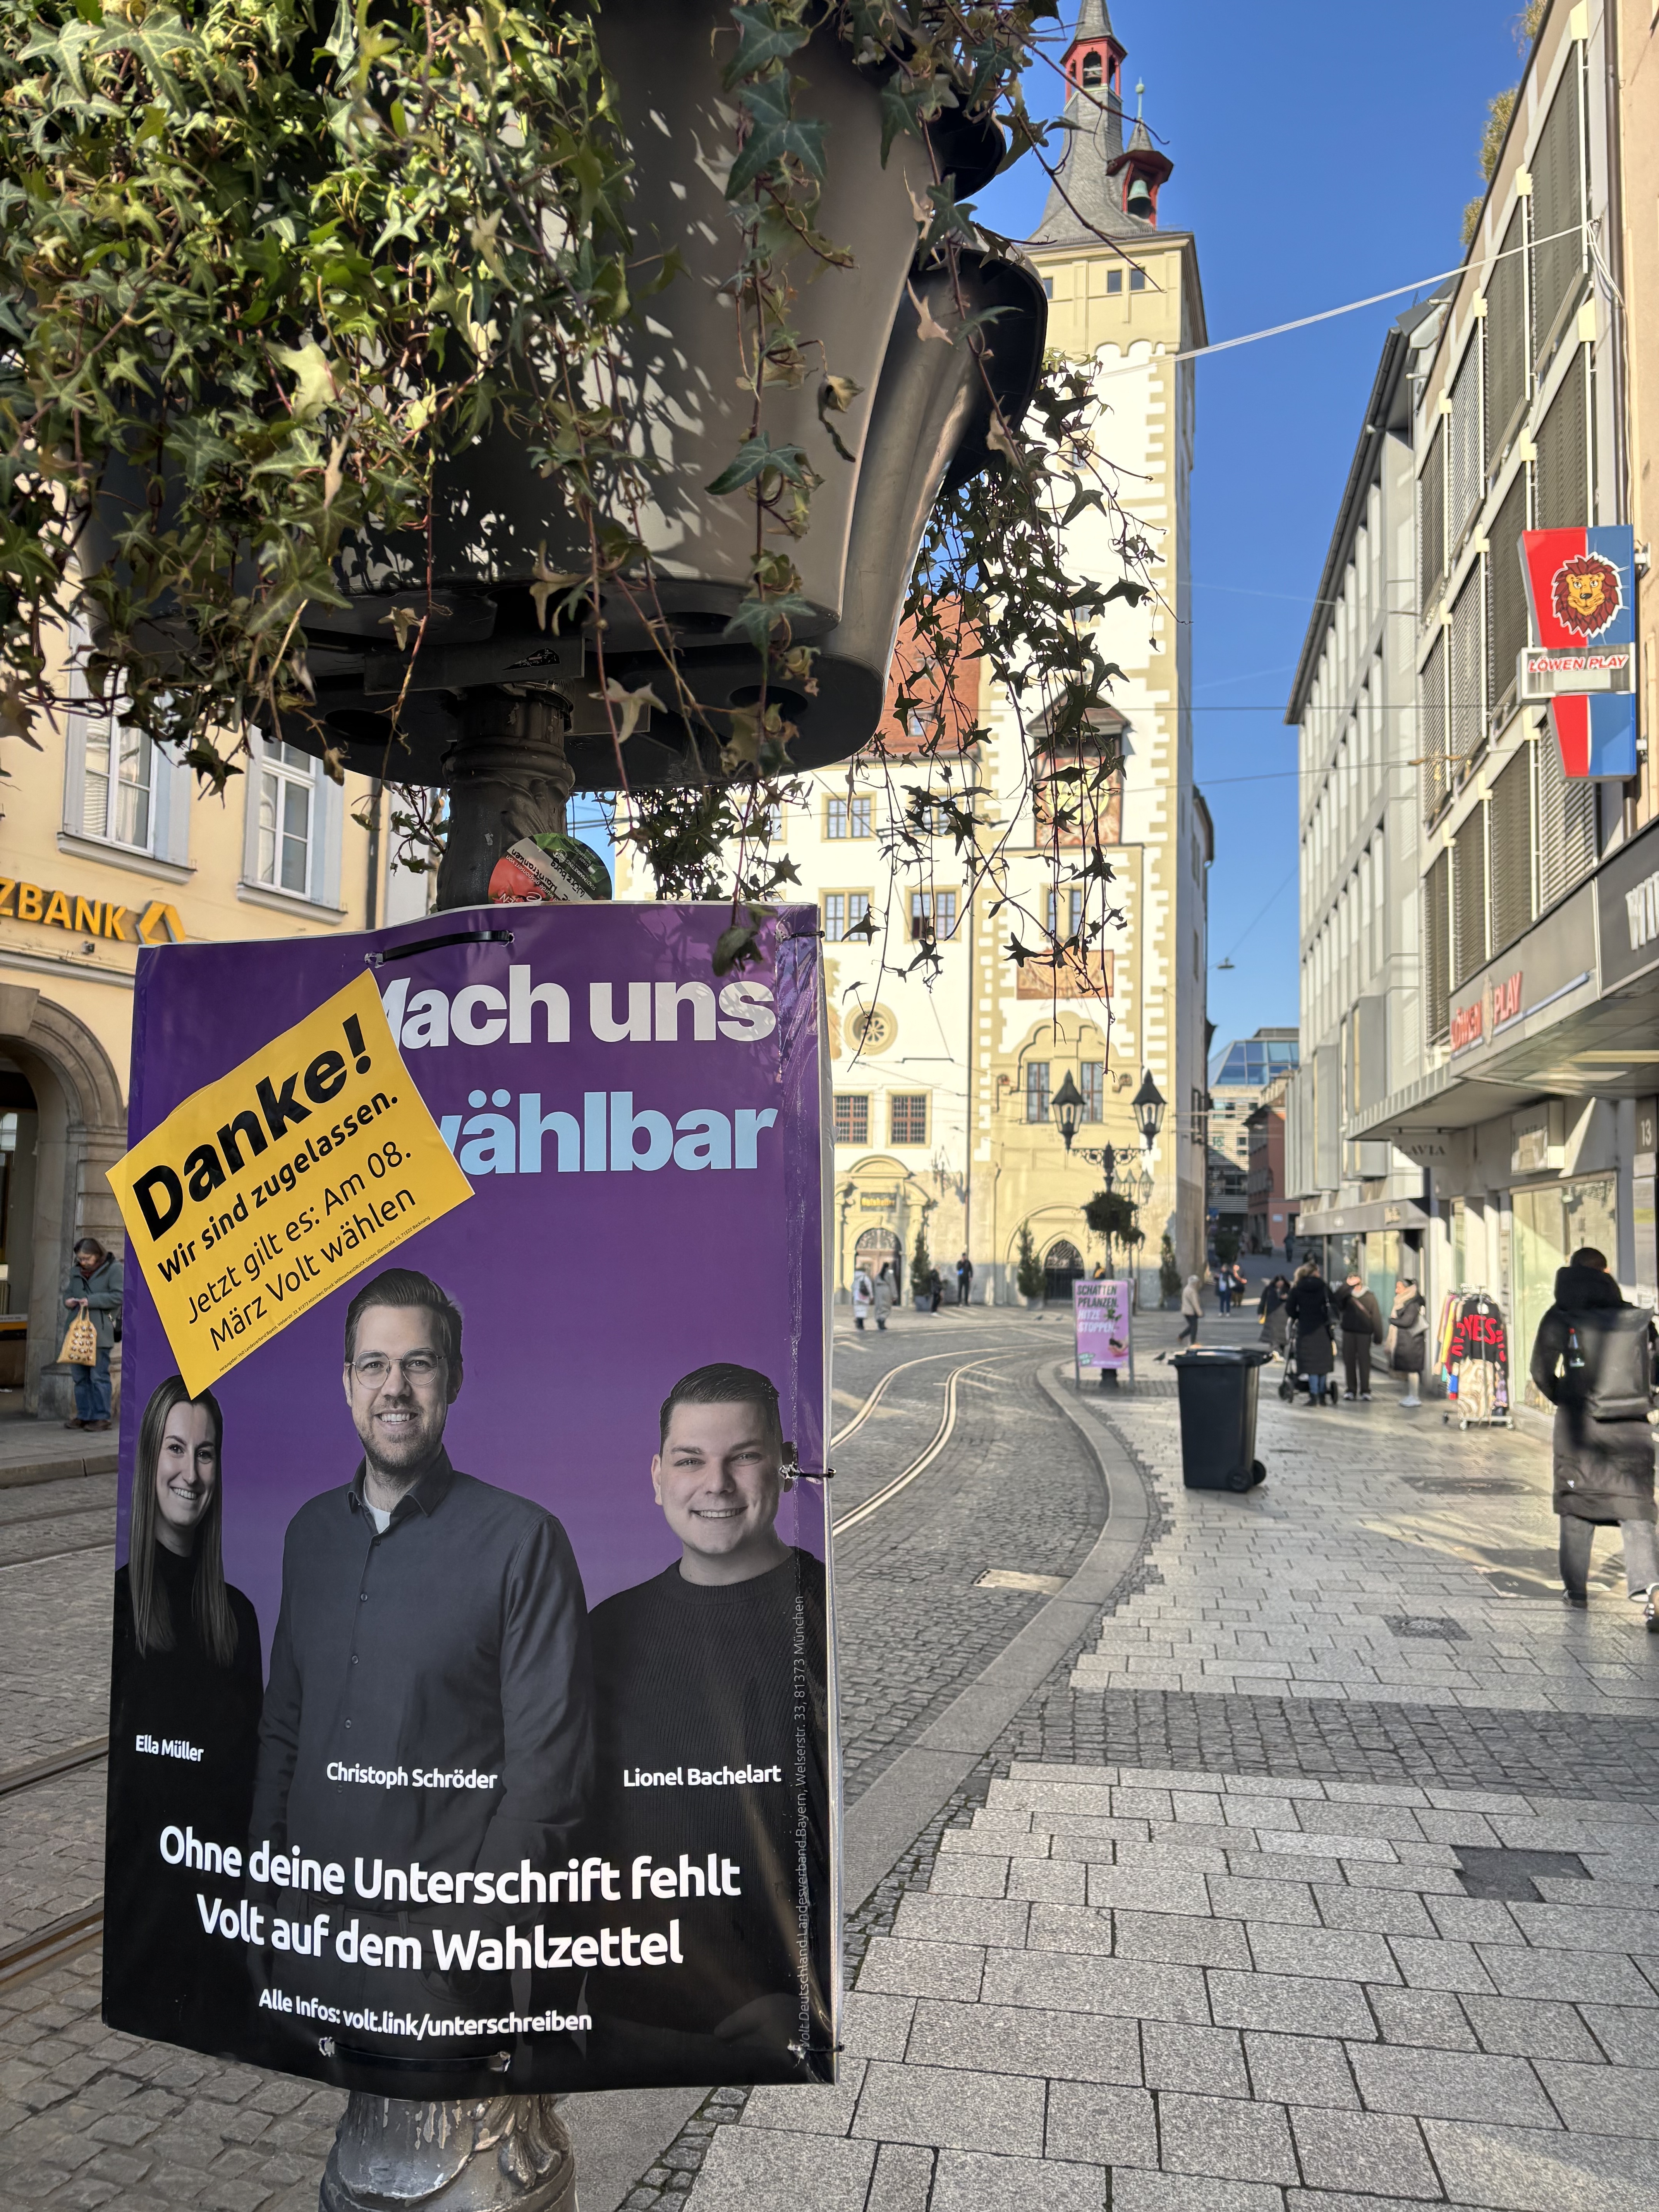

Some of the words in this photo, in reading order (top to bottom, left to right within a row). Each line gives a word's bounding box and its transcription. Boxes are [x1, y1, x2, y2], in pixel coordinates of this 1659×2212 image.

[1529, 657, 1585, 673] LÖWEN
[1587, 655, 1629, 670] PLAY
[506, 855, 516, 864] von
[511, 848, 558, 891] Mainfranken
[514, 862, 541, 886] gesponsert
[566, 859, 596, 891] STADTMARKETING
[579, 857, 589, 867] STADT
[0, 876, 127, 941] ZBANK
[539, 884, 555, 899] wurde
[590, 980, 776, 1042] uns
[1494, 971, 1522, 1025] PLAY
[133, 1013, 372, 1242] Danke!
[1640, 1118, 1652, 1146] 13
[157, 1242, 196, 1283] Wir
[201, 1194, 249, 1250] sind
[251, 1092, 398, 1209] zugelassen.
[188, 1265, 242, 1324] Jetzt
[243, 1231, 283, 1280] gilt
[285, 1206, 320, 1242] es:
[325, 1173, 366, 1216] Am
[367, 1141, 411, 1178] 08.
[210, 1295, 268, 1351] März
[265, 1255, 321, 1302] Volt
[320, 1189, 416, 1263] wählen
[1077, 1285, 1116, 1296] SCHATTEN
[1078, 1297, 1118, 1308] PFLANZEN.
[1079, 1309, 1101, 1320] HITZE
[1463, 1314, 1497, 1345] YES
[792, 1596, 804, 1654] München
[794, 1659, 805, 1698] 81373
[794, 1702, 807, 1720] 33,
[136, 1735, 159, 1755] Ella
[161, 1738, 204, 1762] Müller
[794, 1724, 806, 1786] Welserstr.
[326, 1762, 409, 1789] Christoph
[411, 1769, 498, 1789] Schröder
[623, 1767, 684, 1787] Lionel
[687, 1764, 782, 1786] Bachelart
[795, 1790, 809, 1836] Bayern,
[160, 1825, 242, 1877] Ohne
[249, 1840, 345, 1894] deine
[354, 1856, 622, 1904] Unterschrift
[632, 1853, 742, 1899] fehlt
[795, 1841, 809, 1936] Landesverband
[196, 1893, 265, 1946] Volt
[271, 1913, 330, 1957] auf
[335, 1918, 422, 1970] dem
[431, 1918, 684, 1971] Wahlzettel
[796, 1939, 809, 2019] Deutschland
[258, 1988, 293, 2013] Alle
[295, 1995, 341, 2024] Infos:
[343, 2009, 592, 2041] volt.link/unterschreiben
[798, 2021, 810, 2047] Volt
